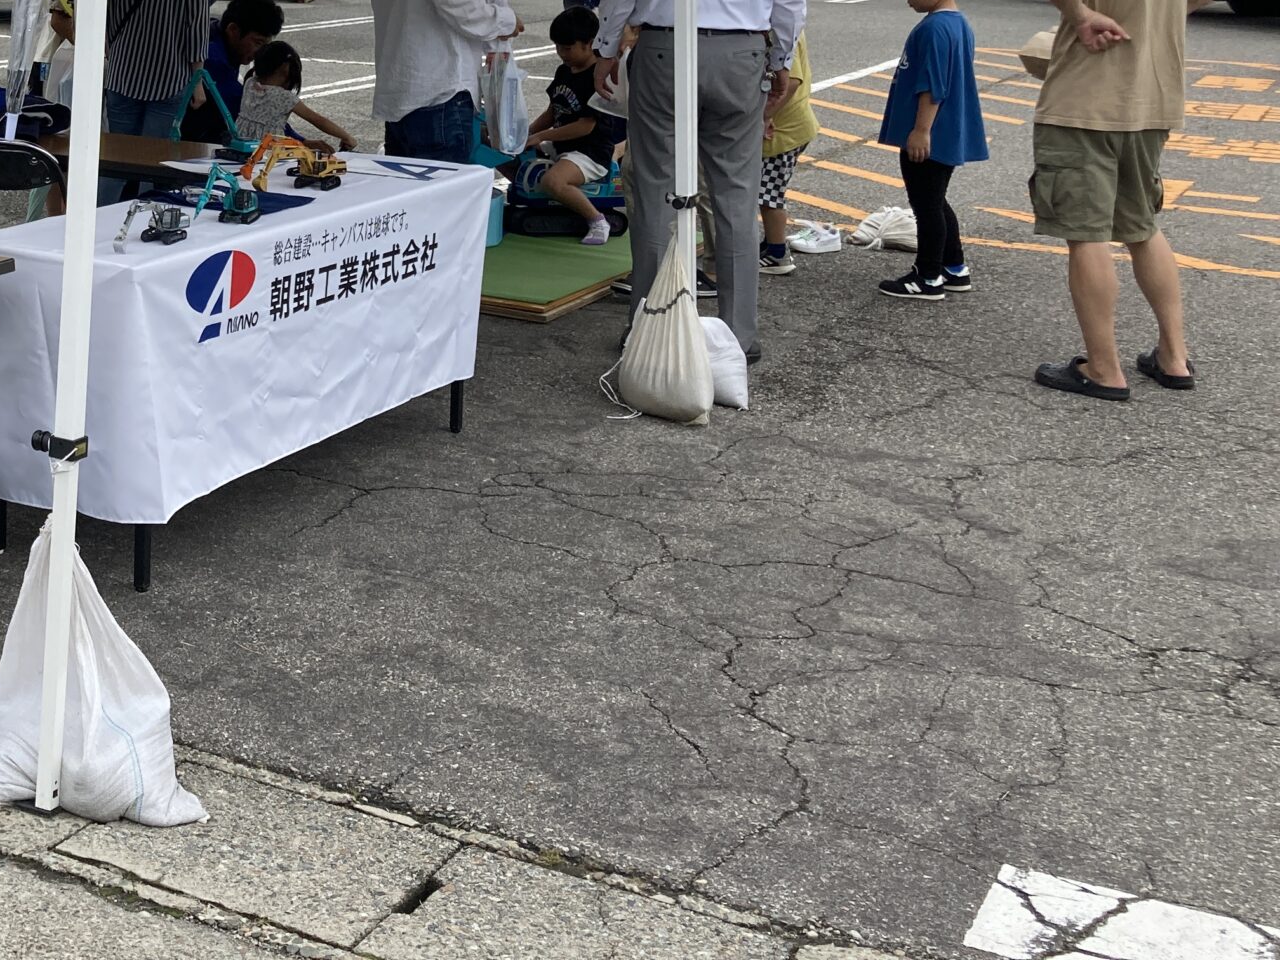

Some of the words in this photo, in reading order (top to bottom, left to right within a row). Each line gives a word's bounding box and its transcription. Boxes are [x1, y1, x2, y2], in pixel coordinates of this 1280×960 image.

[269, 232, 439, 322] 朝野工業株式会社
